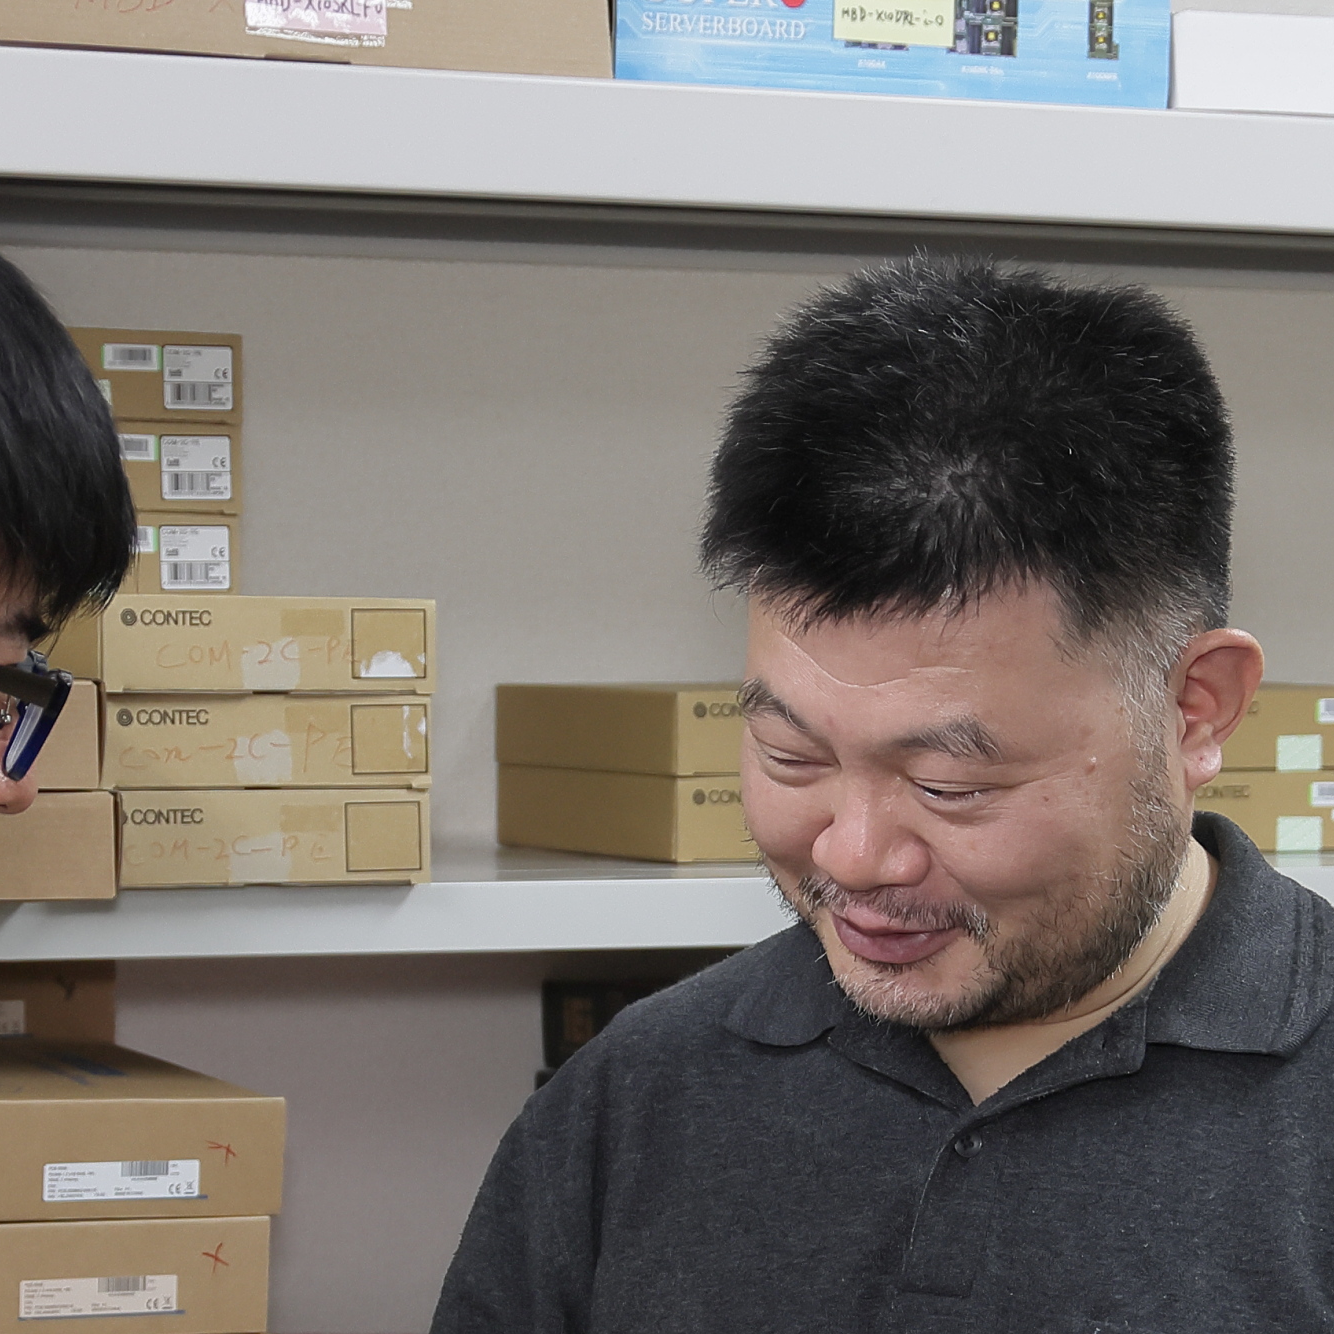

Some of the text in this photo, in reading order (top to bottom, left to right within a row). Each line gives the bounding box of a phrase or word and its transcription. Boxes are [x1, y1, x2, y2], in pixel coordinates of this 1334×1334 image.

[641, 11, 807, 40] SERVERBOARD
[139, 609, 212, 627] CONTEC
[136, 708, 209, 726] CONTEC
[708, 702, 743, 717] CON
[708, 788, 742, 804] CON
[130, 808, 204, 826] CONTEC
